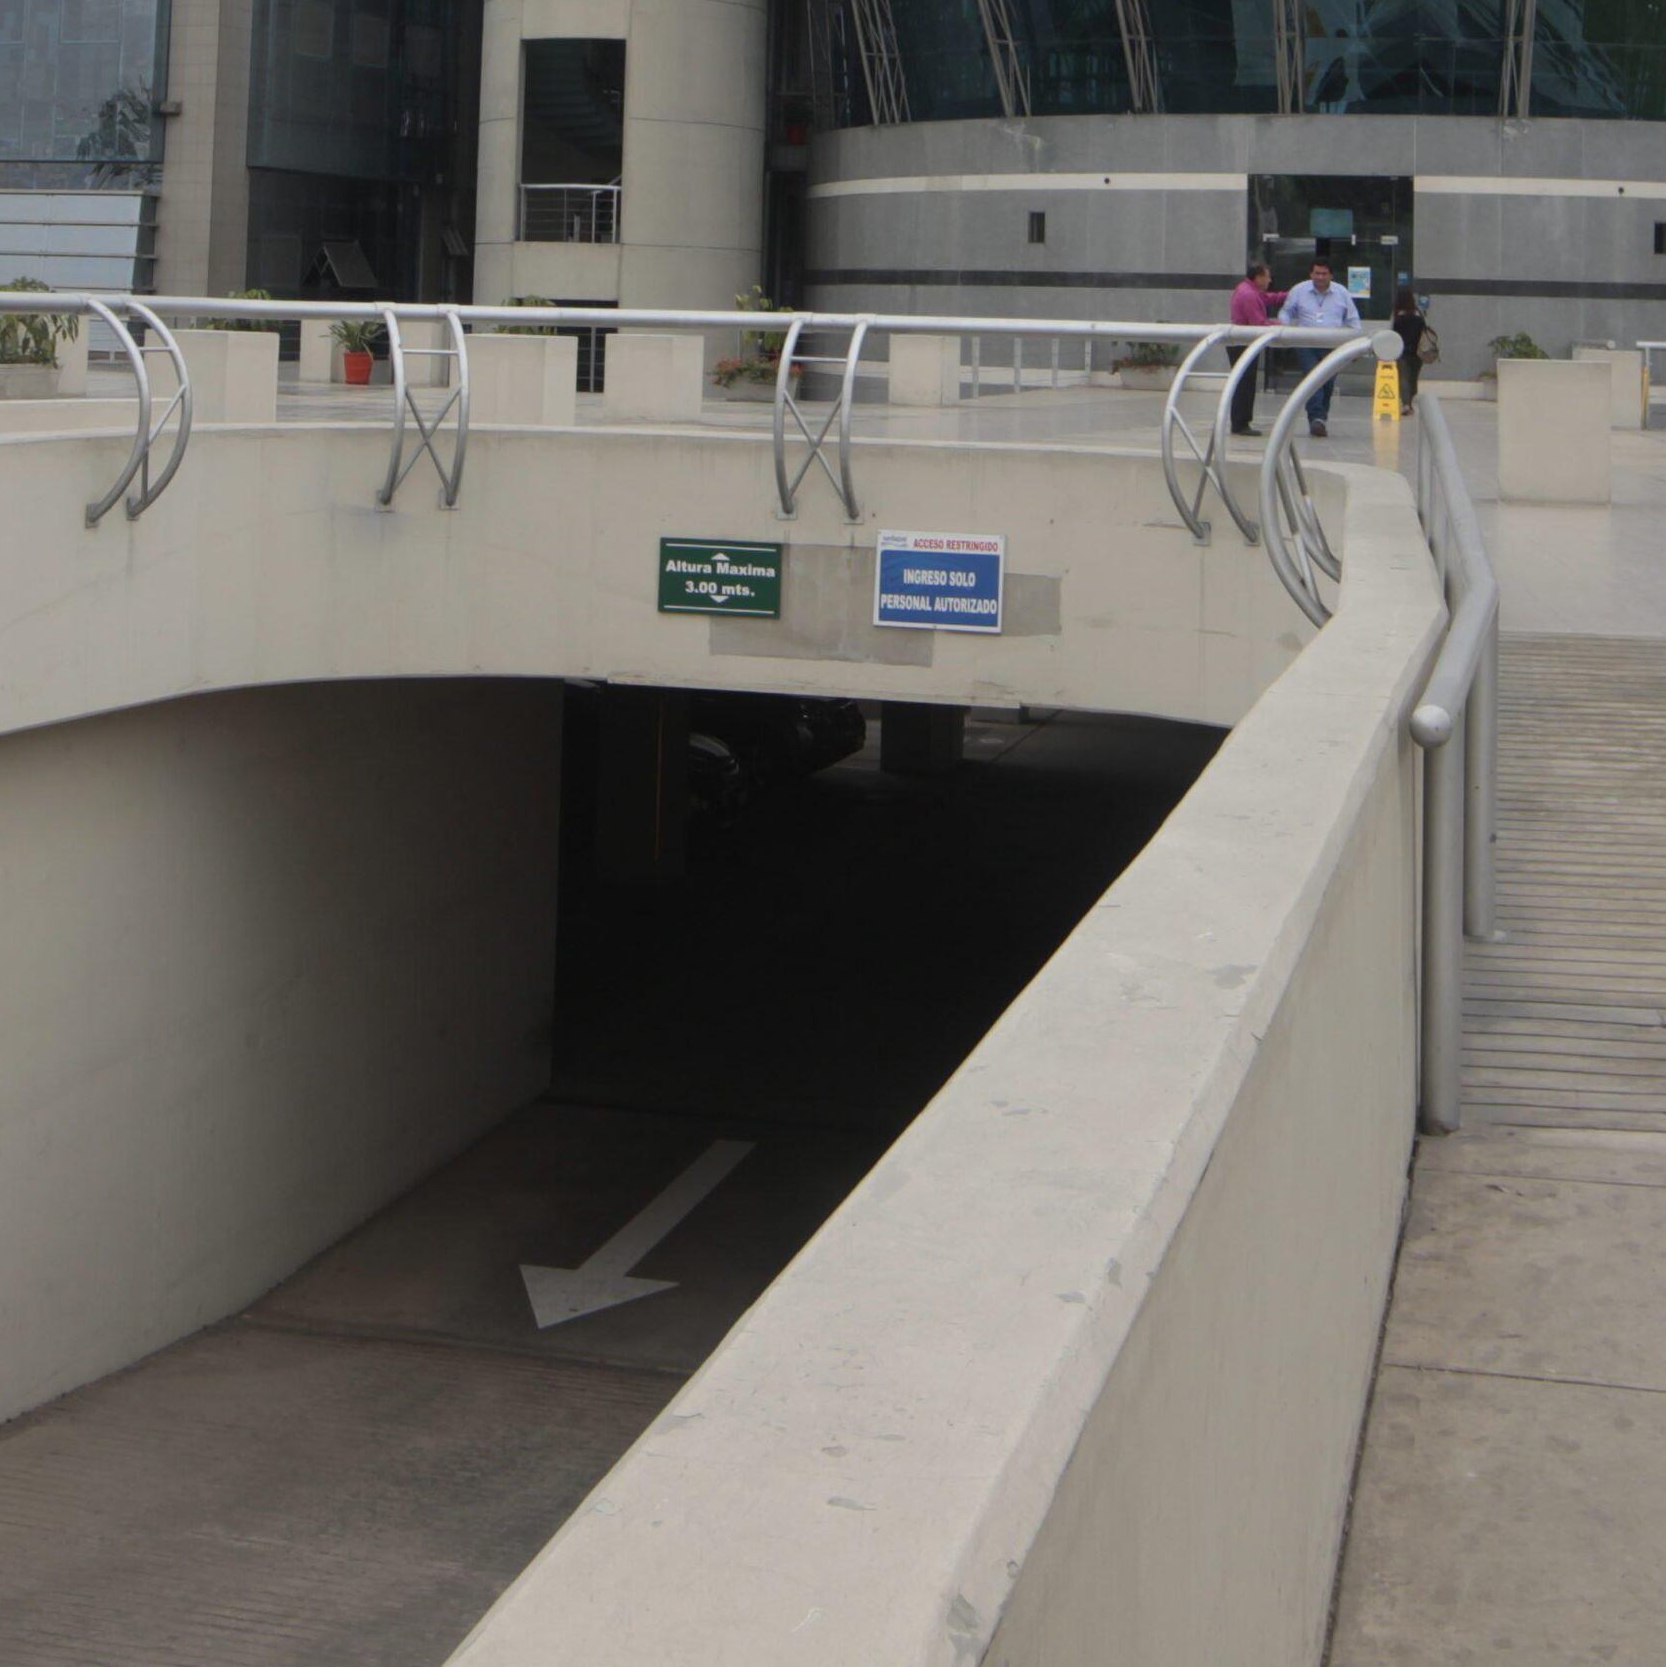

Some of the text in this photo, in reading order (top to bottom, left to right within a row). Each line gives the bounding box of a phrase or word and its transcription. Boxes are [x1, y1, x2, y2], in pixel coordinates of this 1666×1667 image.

[914, 538, 944, 549] ACCESO
[946, 540, 998, 552] RESTRINGIDO
[666, 560, 776, 577] Altura Maxima
[903, 569, 976, 587] INGRESO SOLO
[685, 581, 755, 597] 3.00 mts.
[880, 594, 998, 614] PERSONAL AUTORIZADO
